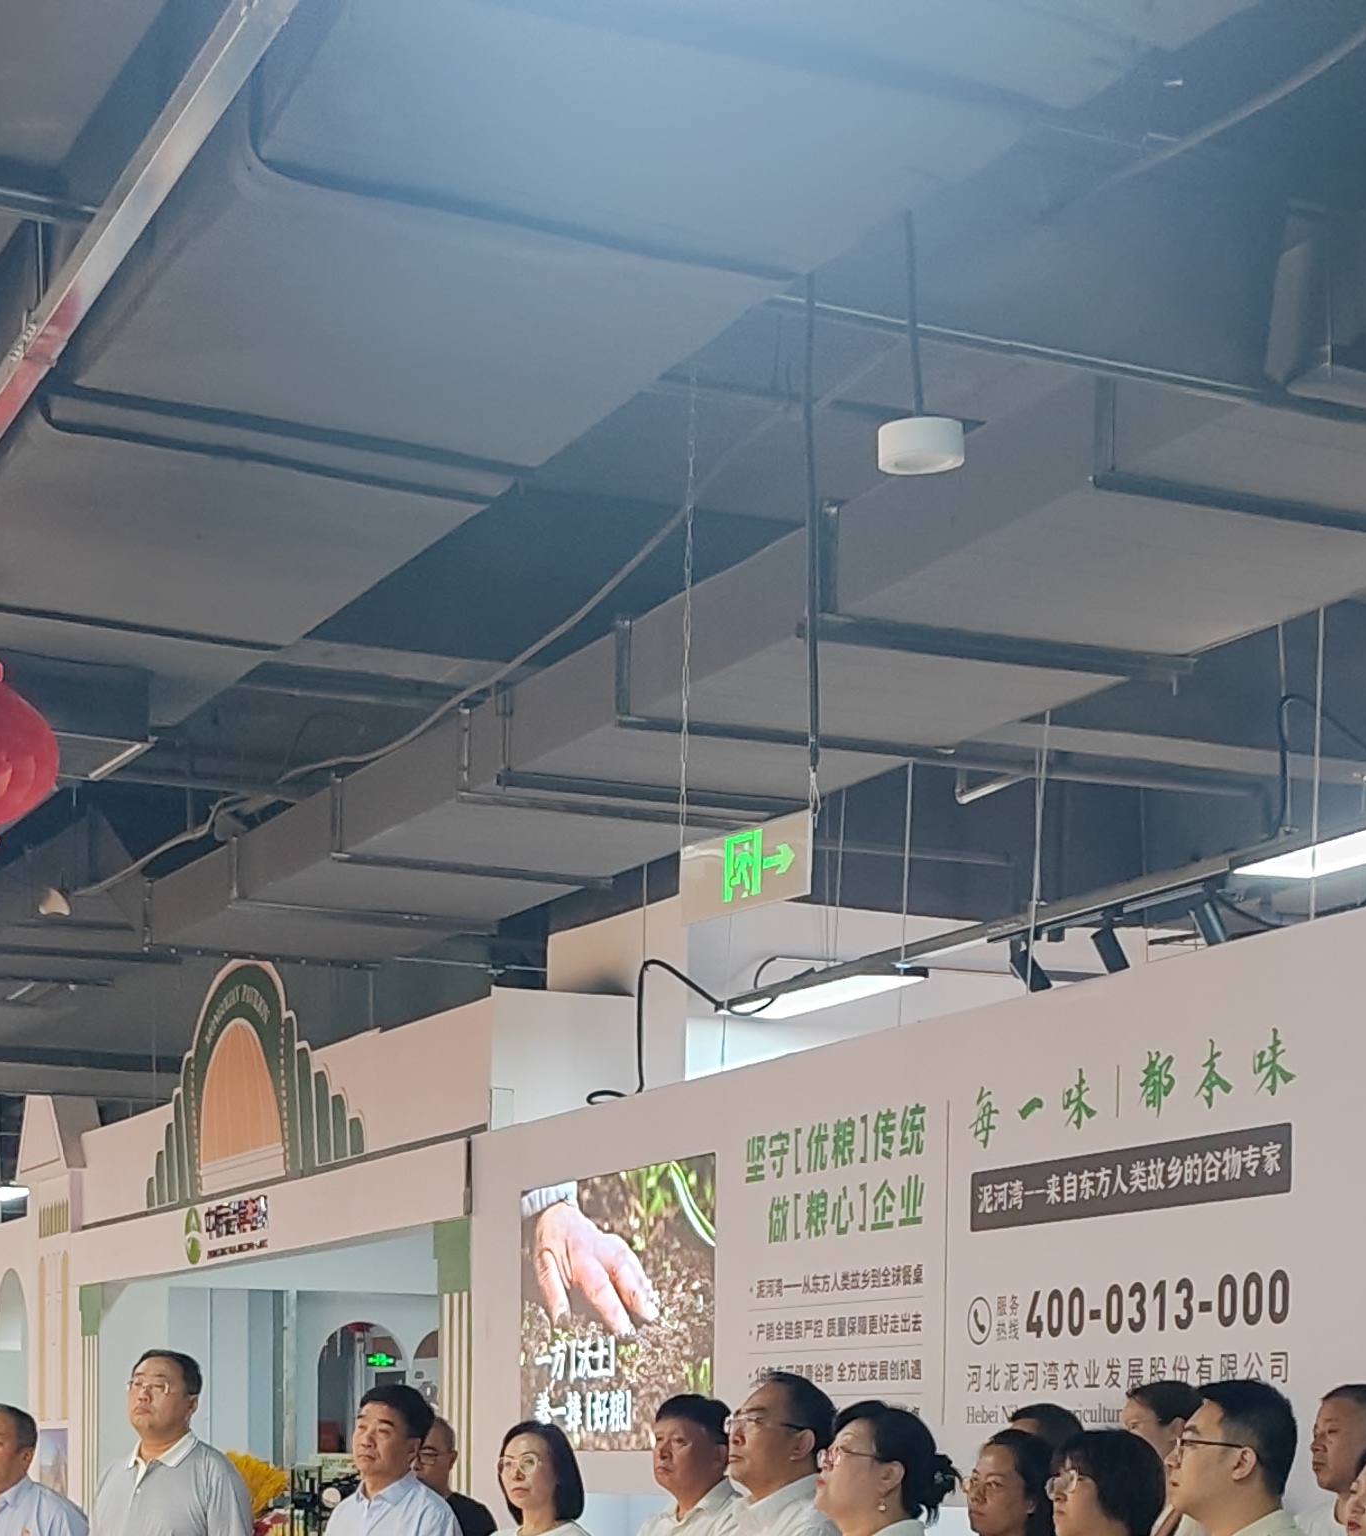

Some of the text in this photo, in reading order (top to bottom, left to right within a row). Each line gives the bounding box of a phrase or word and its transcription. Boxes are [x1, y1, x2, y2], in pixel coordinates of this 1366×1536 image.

[995, 1294, 1020, 1318] 服务
[1025, 1268, 1291, 1339] 400-0313-000
[966, 1351, 1289, 1393] 河北泥河湾农业发展股份有限公司
[966, 1405, 999, 1424] Hebei
